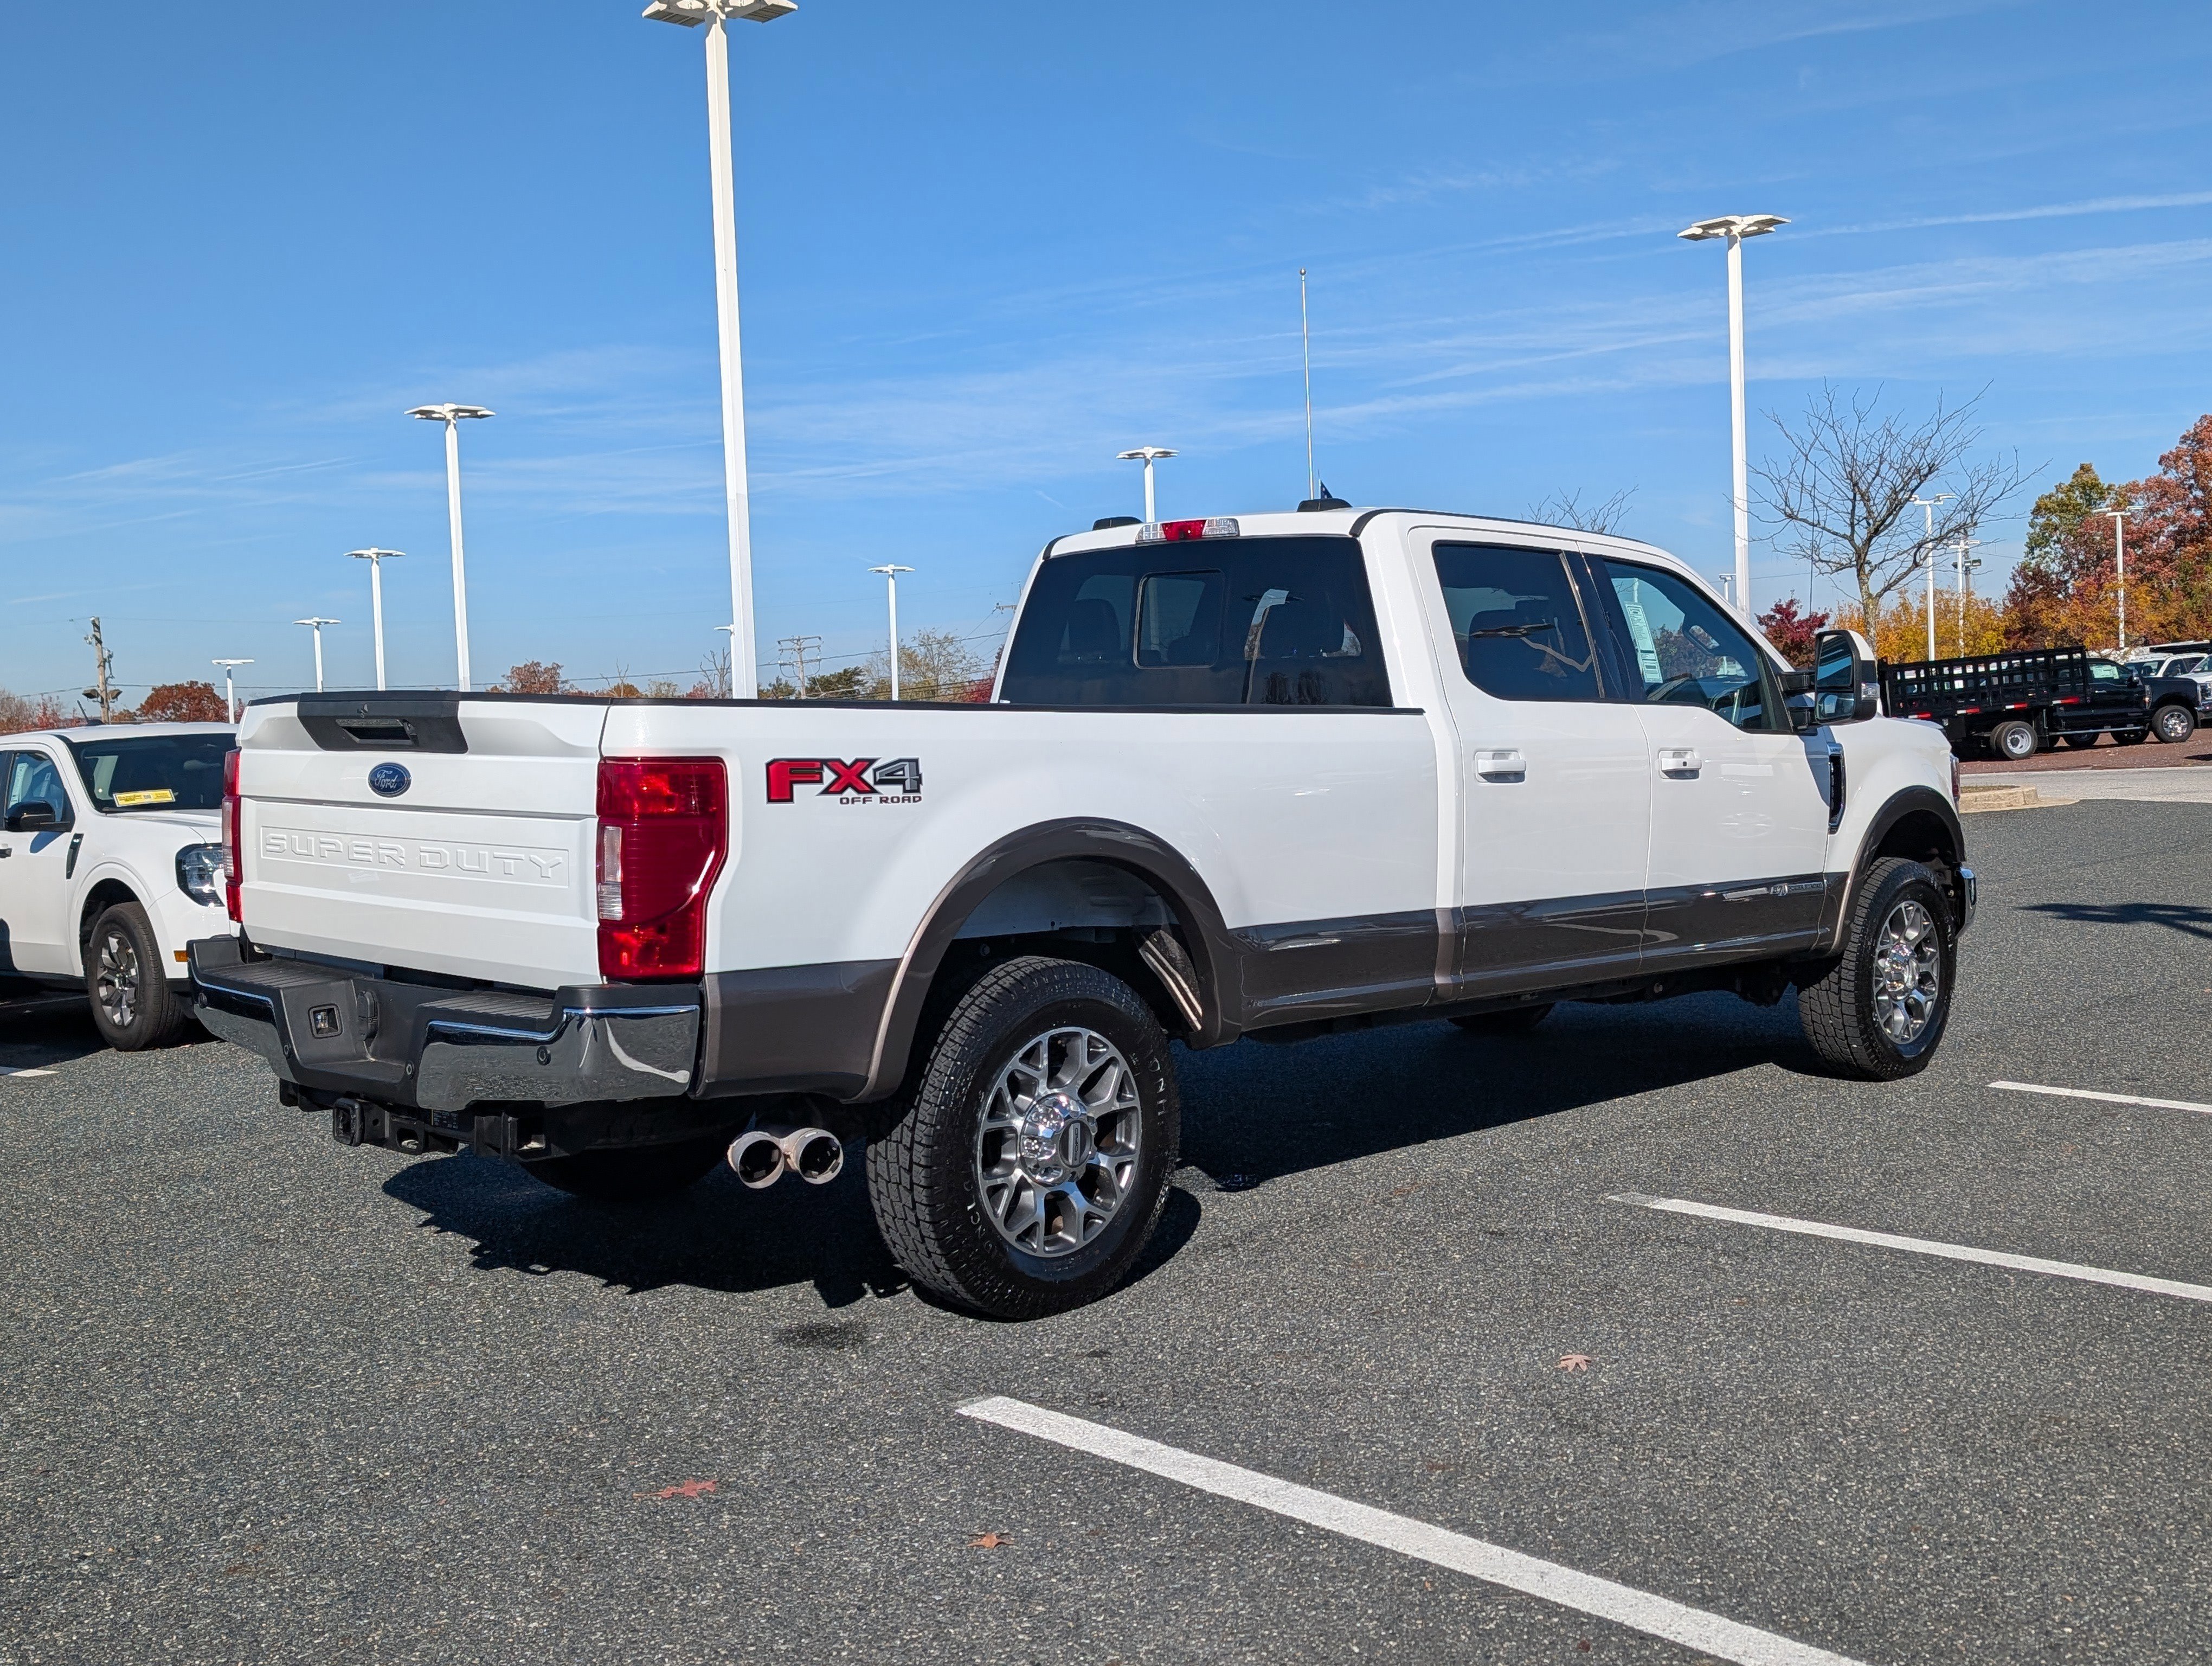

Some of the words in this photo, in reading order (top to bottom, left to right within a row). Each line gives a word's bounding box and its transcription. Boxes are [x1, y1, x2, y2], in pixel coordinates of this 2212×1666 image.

[374, 770, 398, 790] Ford
[766, 758, 923, 804] FX4
[839, 796, 873, 805] OFF
[879, 795, 922, 804] ROAD
[266, 834, 406, 866] SUPER
[420, 846, 563, 879] DUTY
